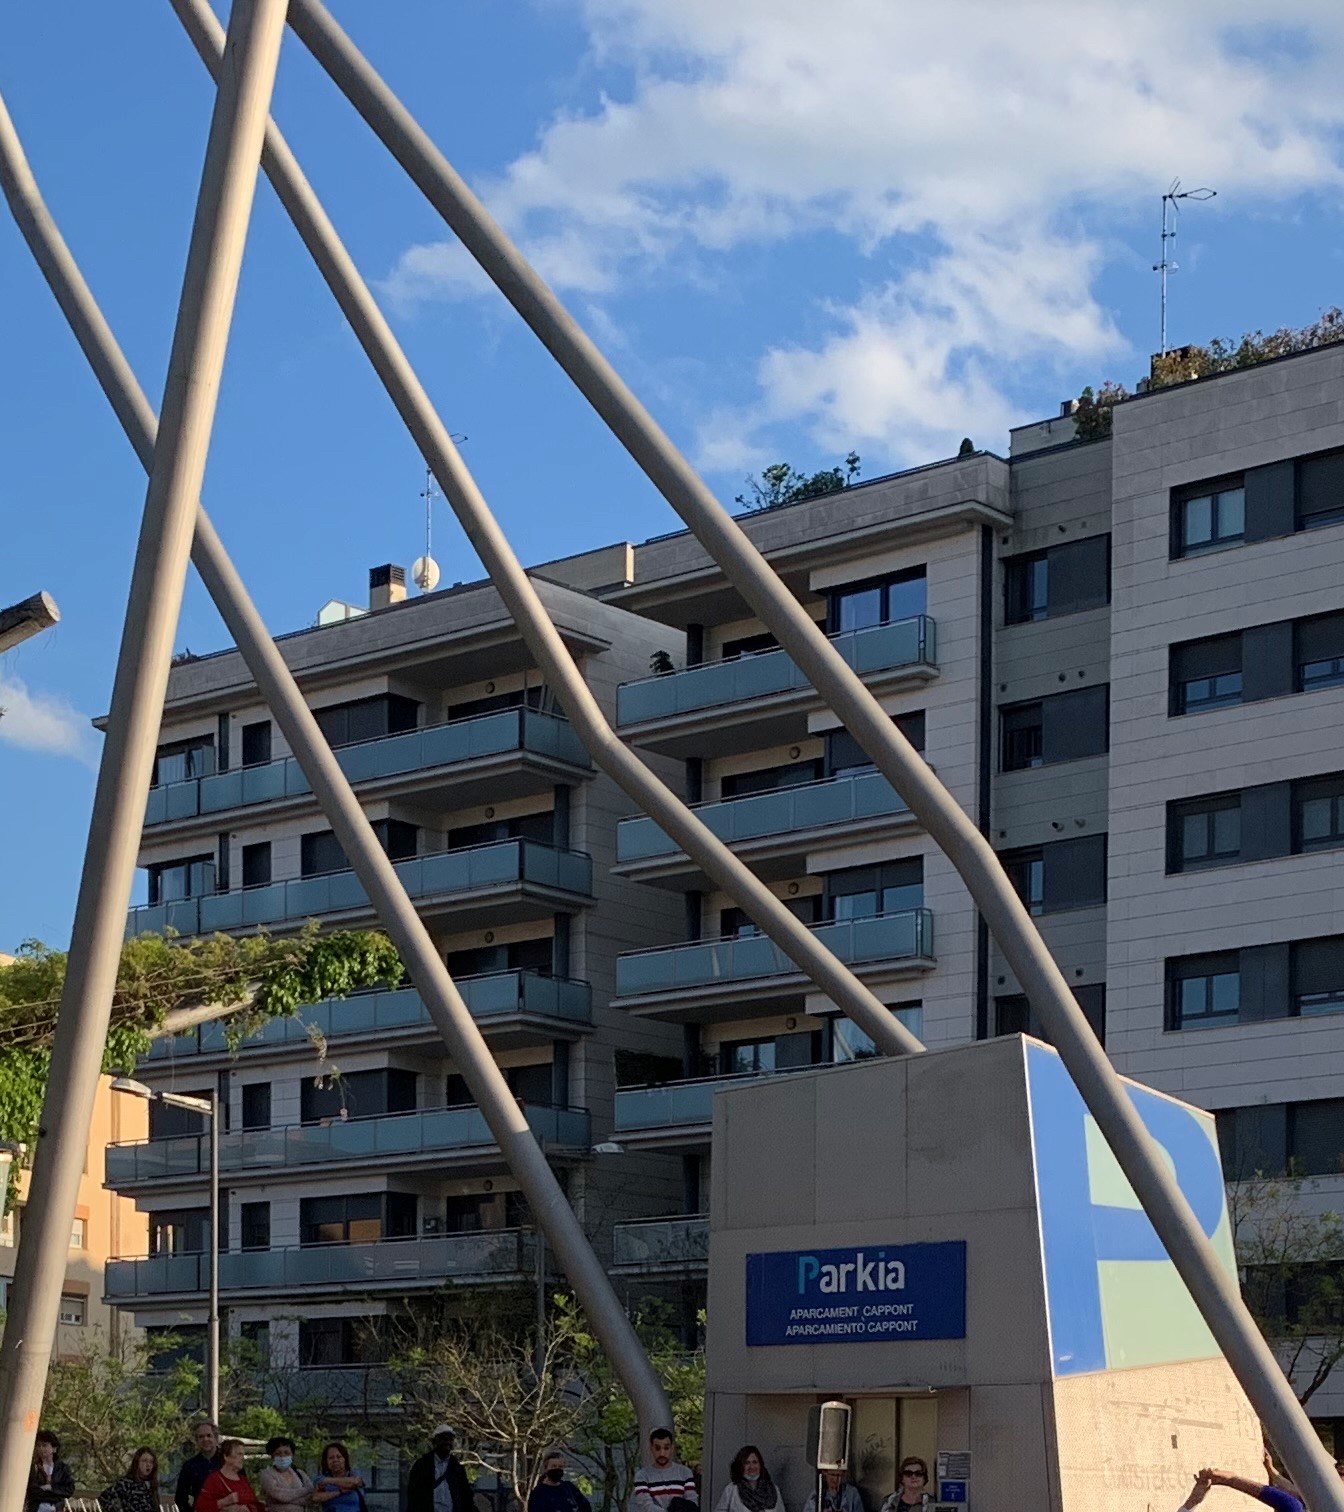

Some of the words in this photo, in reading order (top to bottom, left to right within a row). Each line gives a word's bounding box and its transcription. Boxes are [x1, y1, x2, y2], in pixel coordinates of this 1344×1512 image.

[798, 1252, 905, 1295] Parkia
[790, 1306, 859, 1320] APARCAMENT
[863, 1304, 914, 1317] CAPPONT
[785, 1322, 865, 1336] APARCAMIENTO
[867, 1320, 918, 1334] CAPPONT
